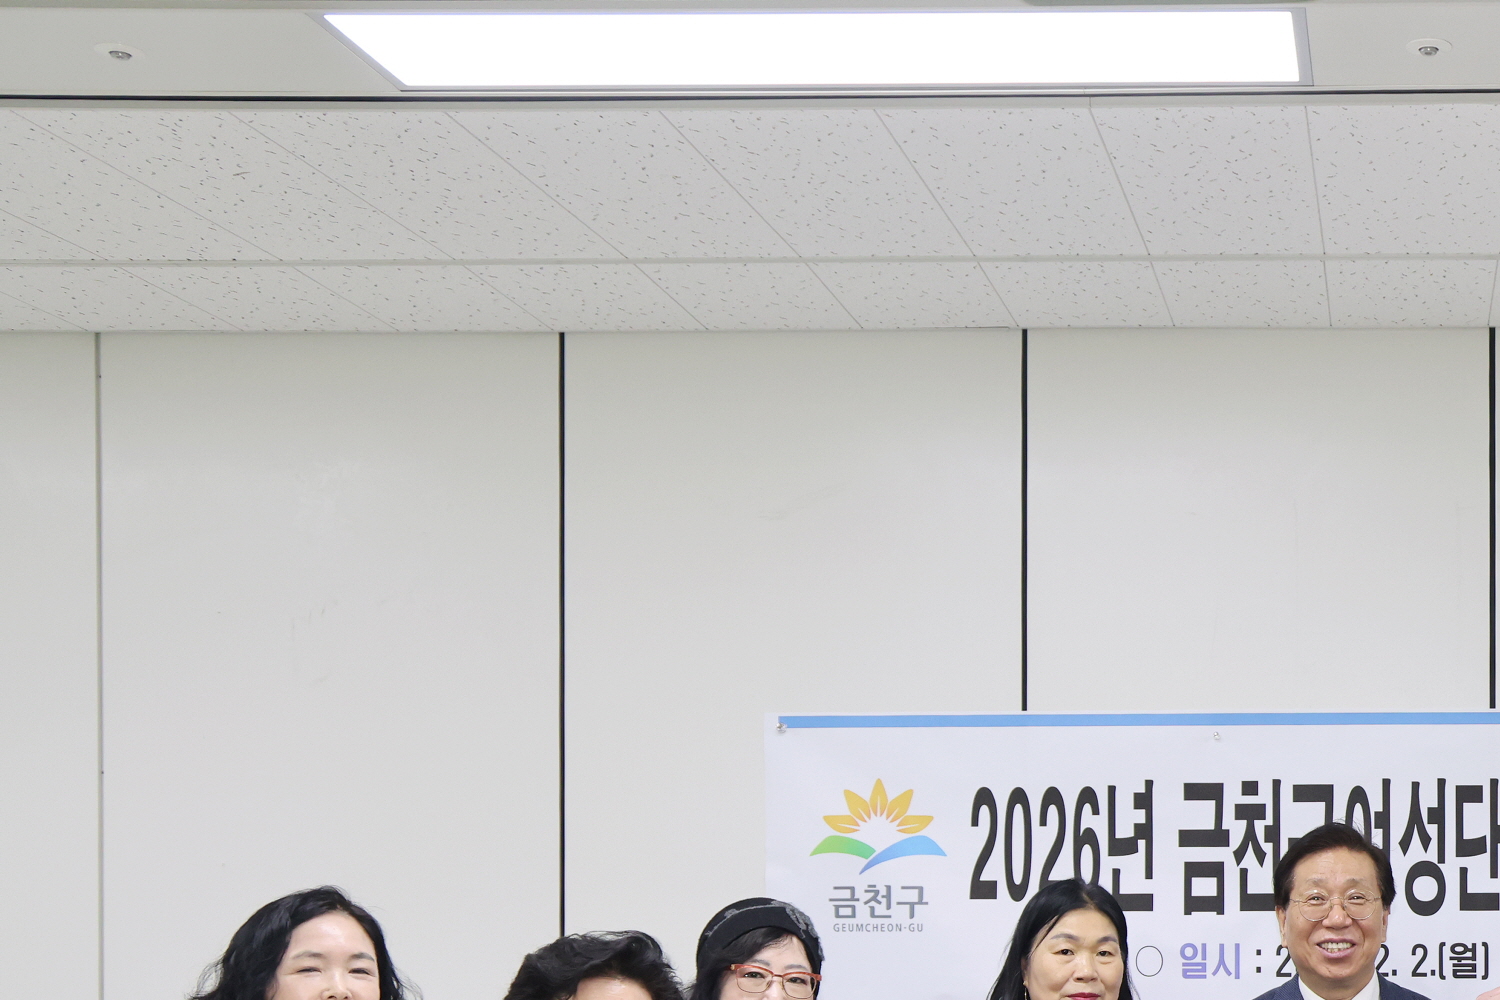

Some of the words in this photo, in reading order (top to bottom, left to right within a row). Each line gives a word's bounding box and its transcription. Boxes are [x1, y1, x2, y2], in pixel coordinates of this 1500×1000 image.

[970, 779, 1153, 911] 2026년
[828, 884, 929, 920] 금천구
[833, 923, 924, 933] GEUMCHEON-GU
[1179, 943, 1240, 979] 일시
